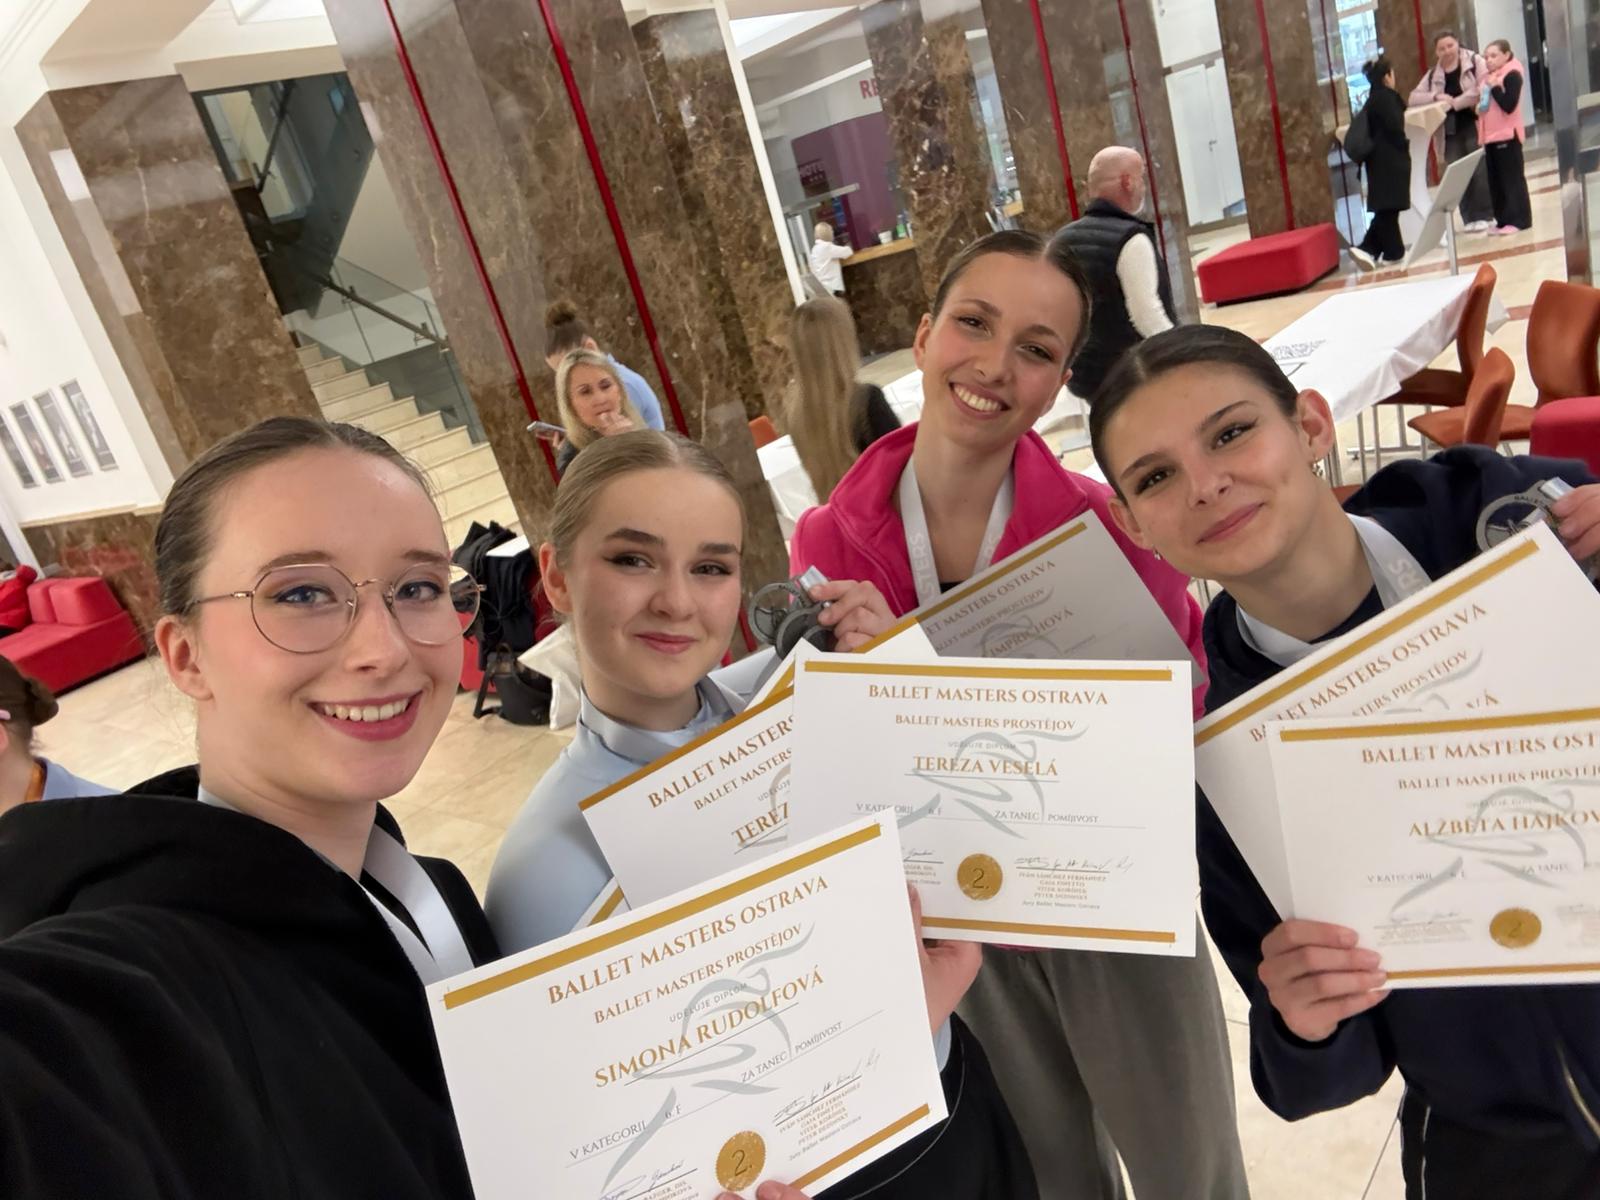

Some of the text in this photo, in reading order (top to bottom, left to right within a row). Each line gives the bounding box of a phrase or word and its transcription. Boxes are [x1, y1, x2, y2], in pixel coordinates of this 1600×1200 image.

[943, 592, 997, 626] MASTERS
[998, 560, 1056, 597] OSTRAVA
[1310, 655, 1392, 711] MASTERS
[1392, 603, 1487, 662] OSTRAVA
[868, 684, 1108, 706] BALLET MASTERS OSTRAVA
[895, 714, 1076, 732] BALLET MASTERS PROSTĚJOV
[1361, 744, 1436, 764] BALLET
[1444, 737, 1547, 759] MASTERS
[913, 755, 1058, 777] TEREZA VESELÁ
[1397, 776, 1451, 790] BALLET
[1456, 771, 1527, 786] MASTERS
[647, 759, 717, 809] BALLET
[693, 778, 740, 811] BALLET
[856, 803, 864, 811] V
[995, 811, 1008, 820] ZA
[1010, 811, 1040, 821] TANEC
[971, 867, 990, 889] 2.
[548, 876, 829, 1005] BALLET MASTERS OSTRAVA
[594, 922, 803, 1024] BALLET MASTERS PROSTĚJOV
[713, 981, 749, 1007] DIPLOM
[594, 965, 824, 1088] SIMONA RUDOLFOVÁ
[569, 1148, 579, 1160] V
[582, 1120, 648, 1156] KATEGORII
[741, 1069, 755, 1082] ZA
[755, 1050, 788, 1074] TANEC
[731, 1147, 754, 1177] 2.
